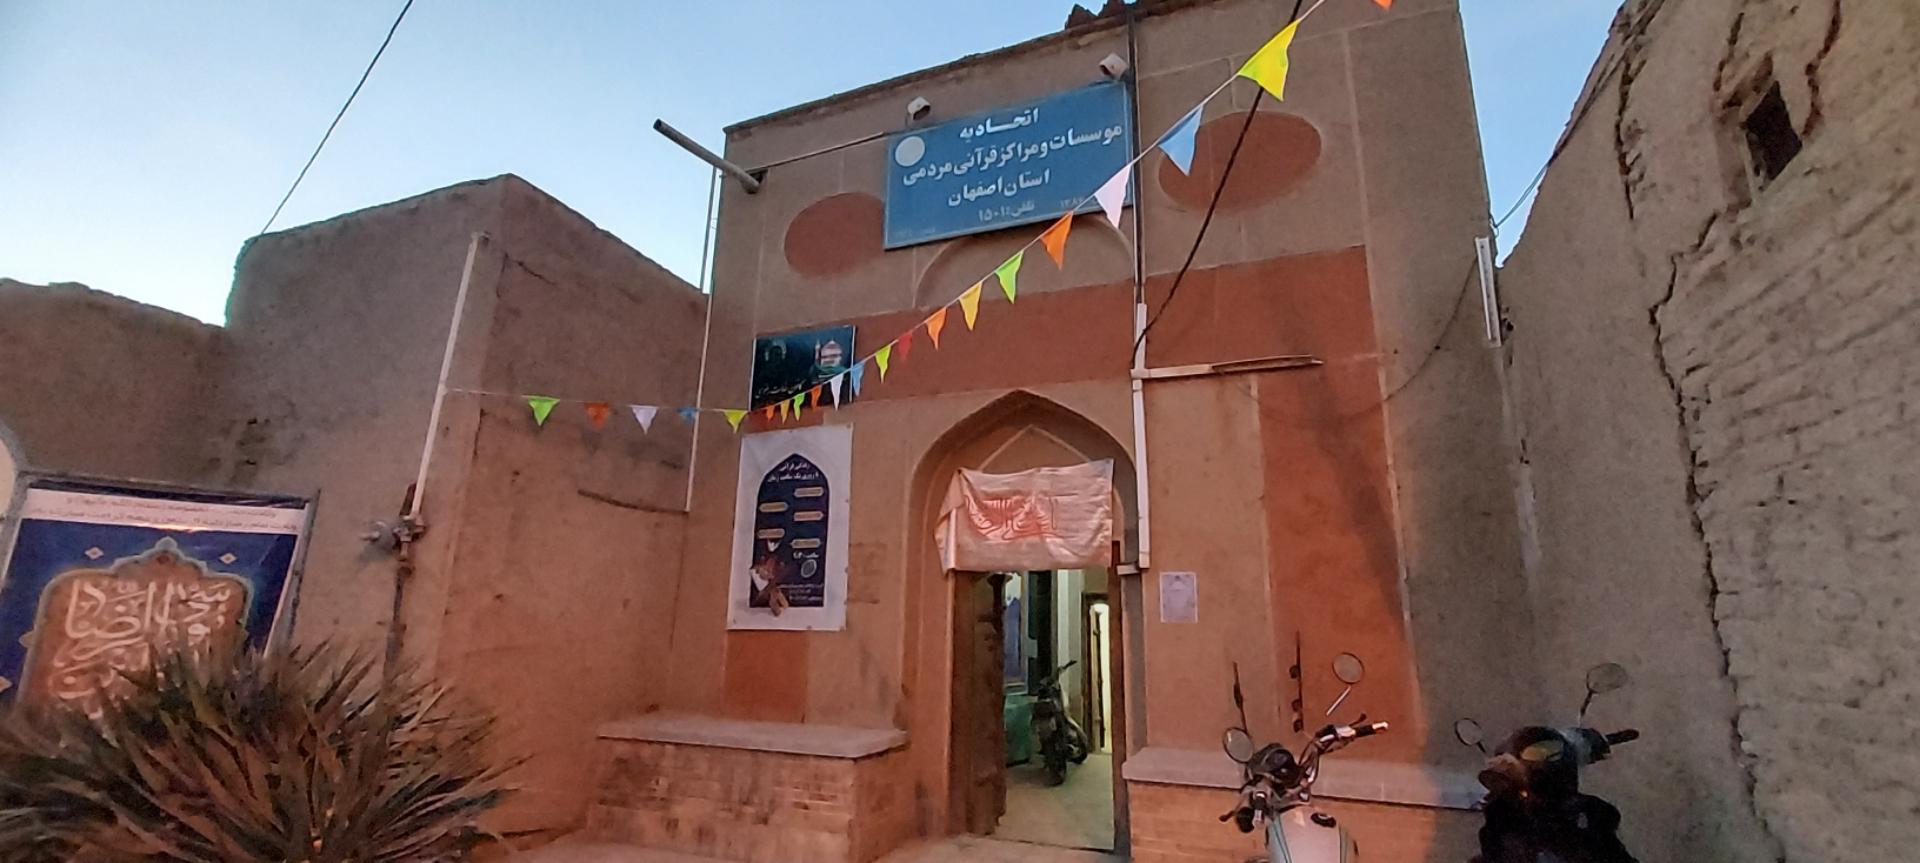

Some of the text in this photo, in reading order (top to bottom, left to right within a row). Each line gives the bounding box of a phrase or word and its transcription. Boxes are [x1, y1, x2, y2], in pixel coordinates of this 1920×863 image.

[960, 107, 1039, 143] اتحادیه
[1050, 124, 1122, 151] موسسات
[954, 146, 997, 175] قرآنی
[996, 141, 1040, 168] مراکز
[903, 159, 953, 186] مردمی
[948, 168, 1051, 207] استان اصفهان
